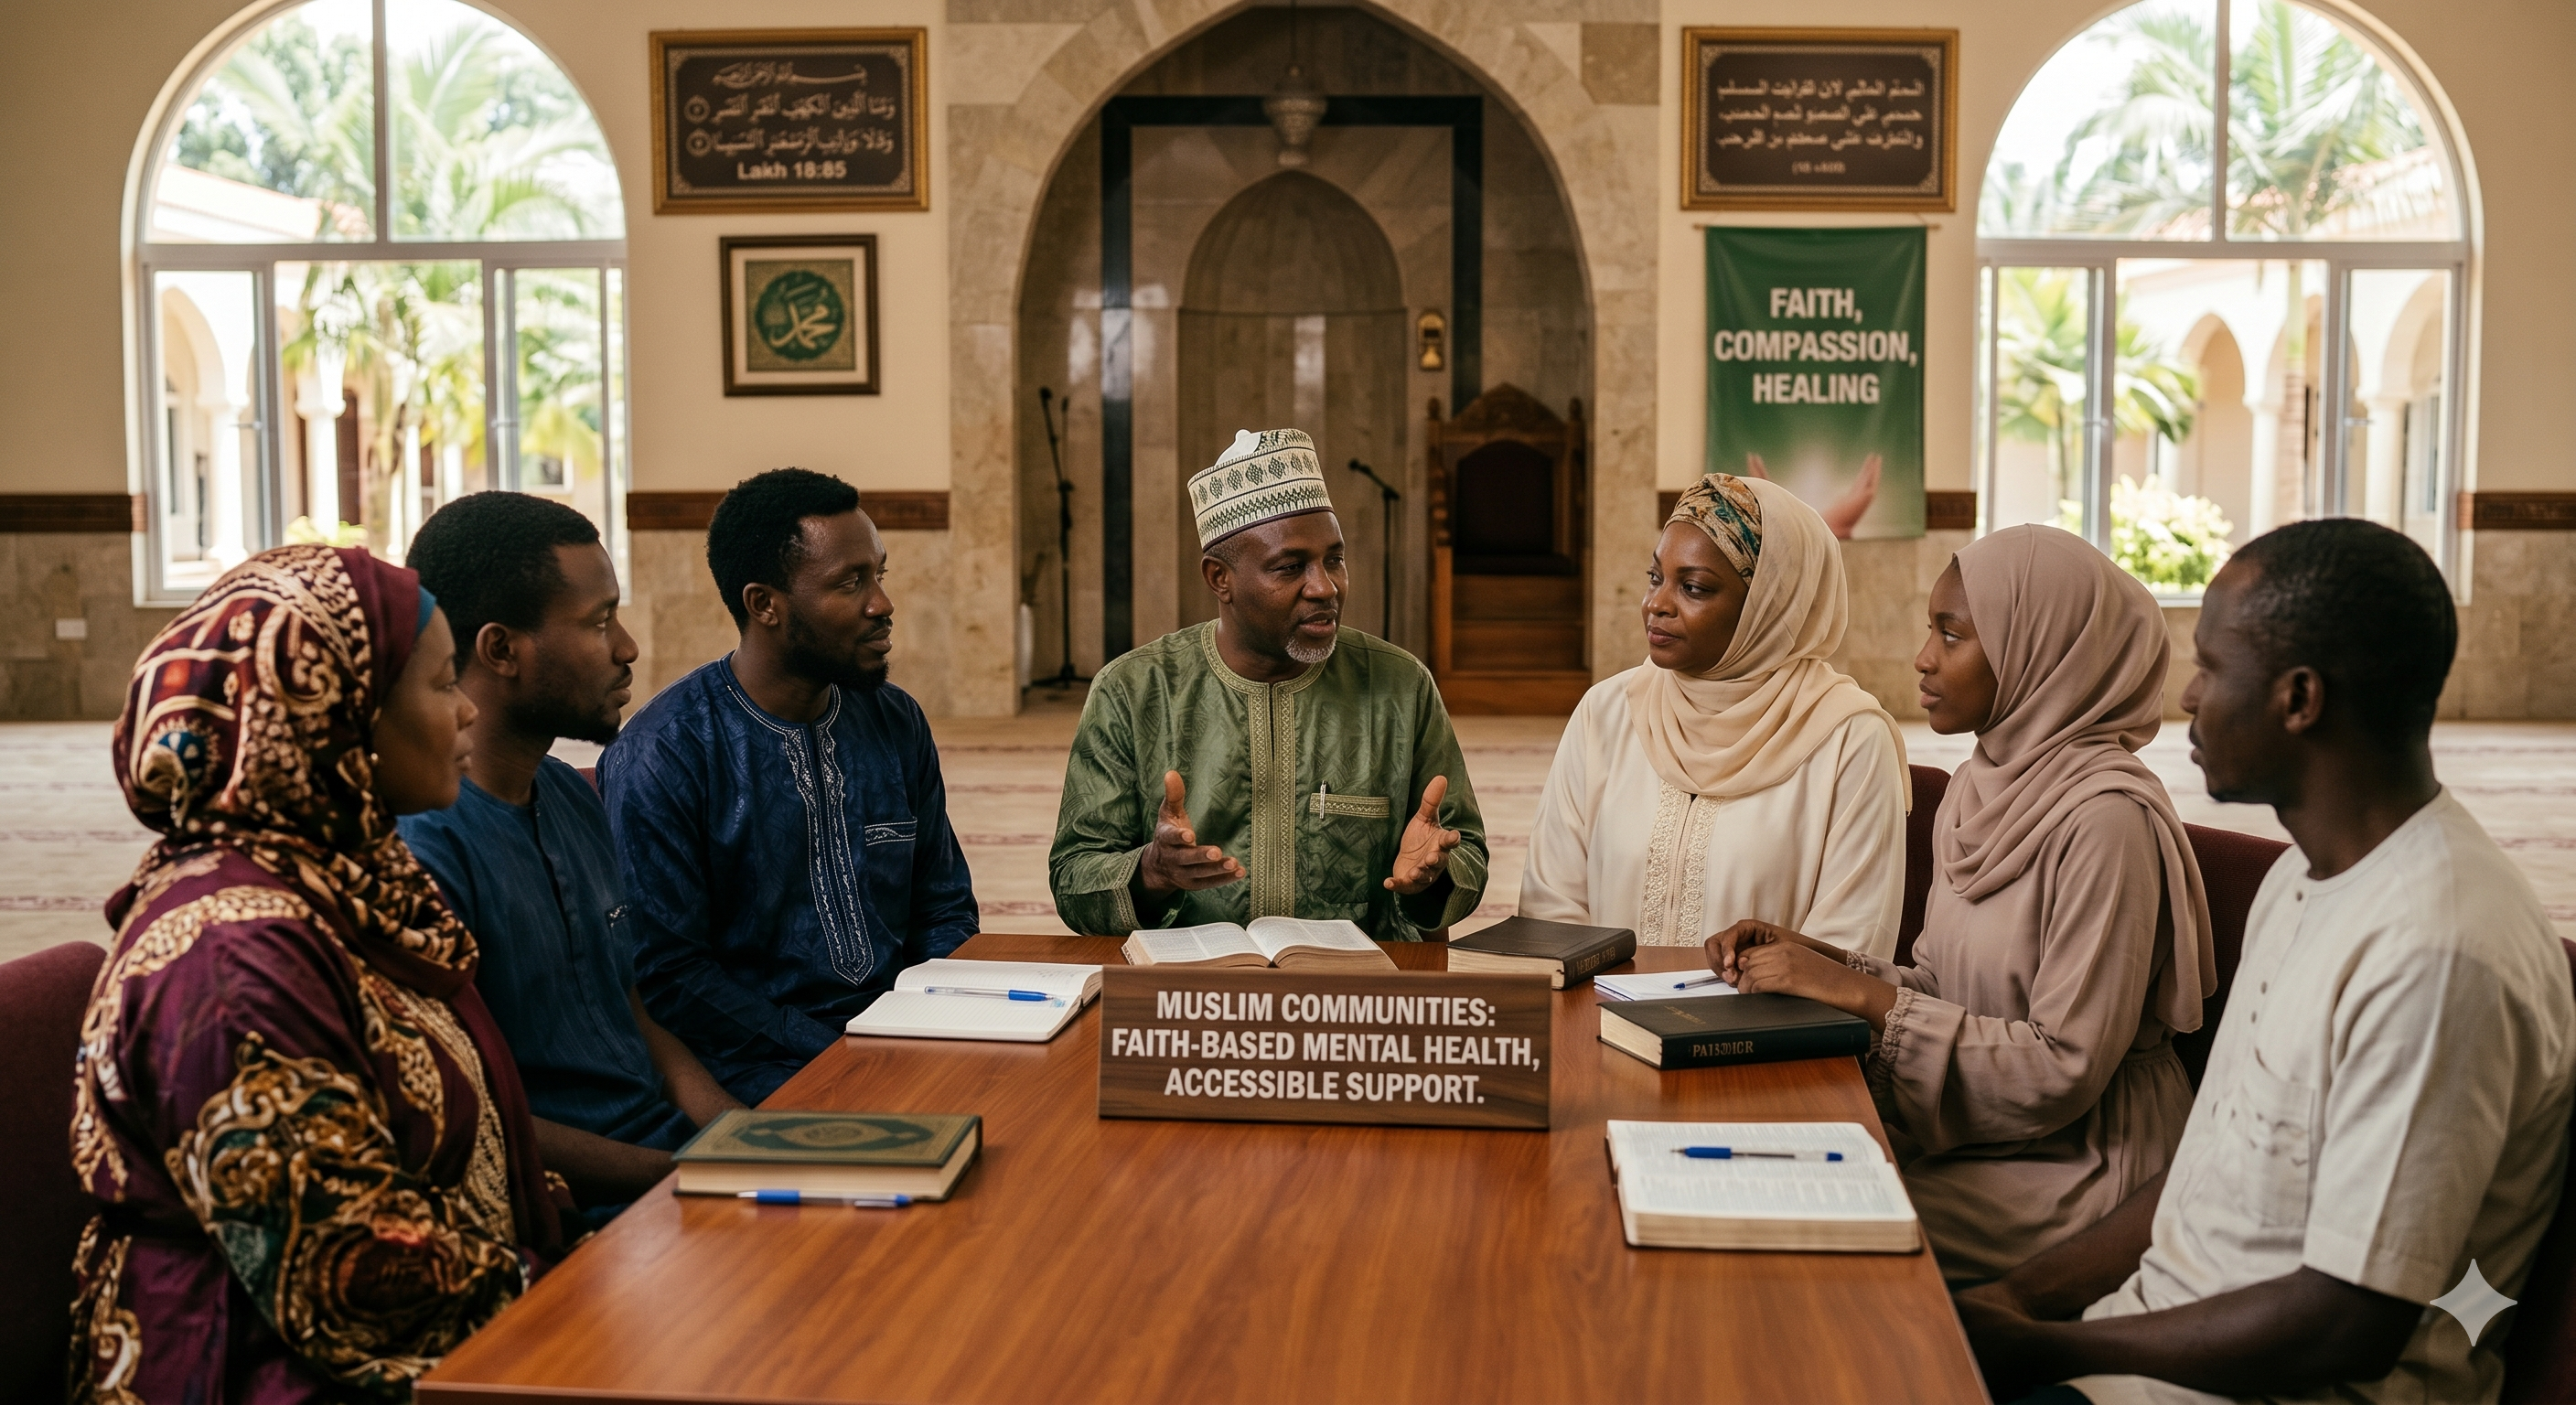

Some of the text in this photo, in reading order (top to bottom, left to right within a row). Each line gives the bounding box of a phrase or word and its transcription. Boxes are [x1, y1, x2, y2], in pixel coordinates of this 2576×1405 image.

[1770, 287, 1862, 324] FAITH,
[1713, 329, 1917, 367] COMPASSION,
[1753, 373, 1881, 404] HEALING
[1156, 991, 1496, 1027] MUSLIM COMMUNITIES:
[1111, 1027, 1540, 1072] FAITH-BASED MENTAL HEALTH,
[1164, 1067, 1485, 1104] ACCESSIBLE SUPPORT.
